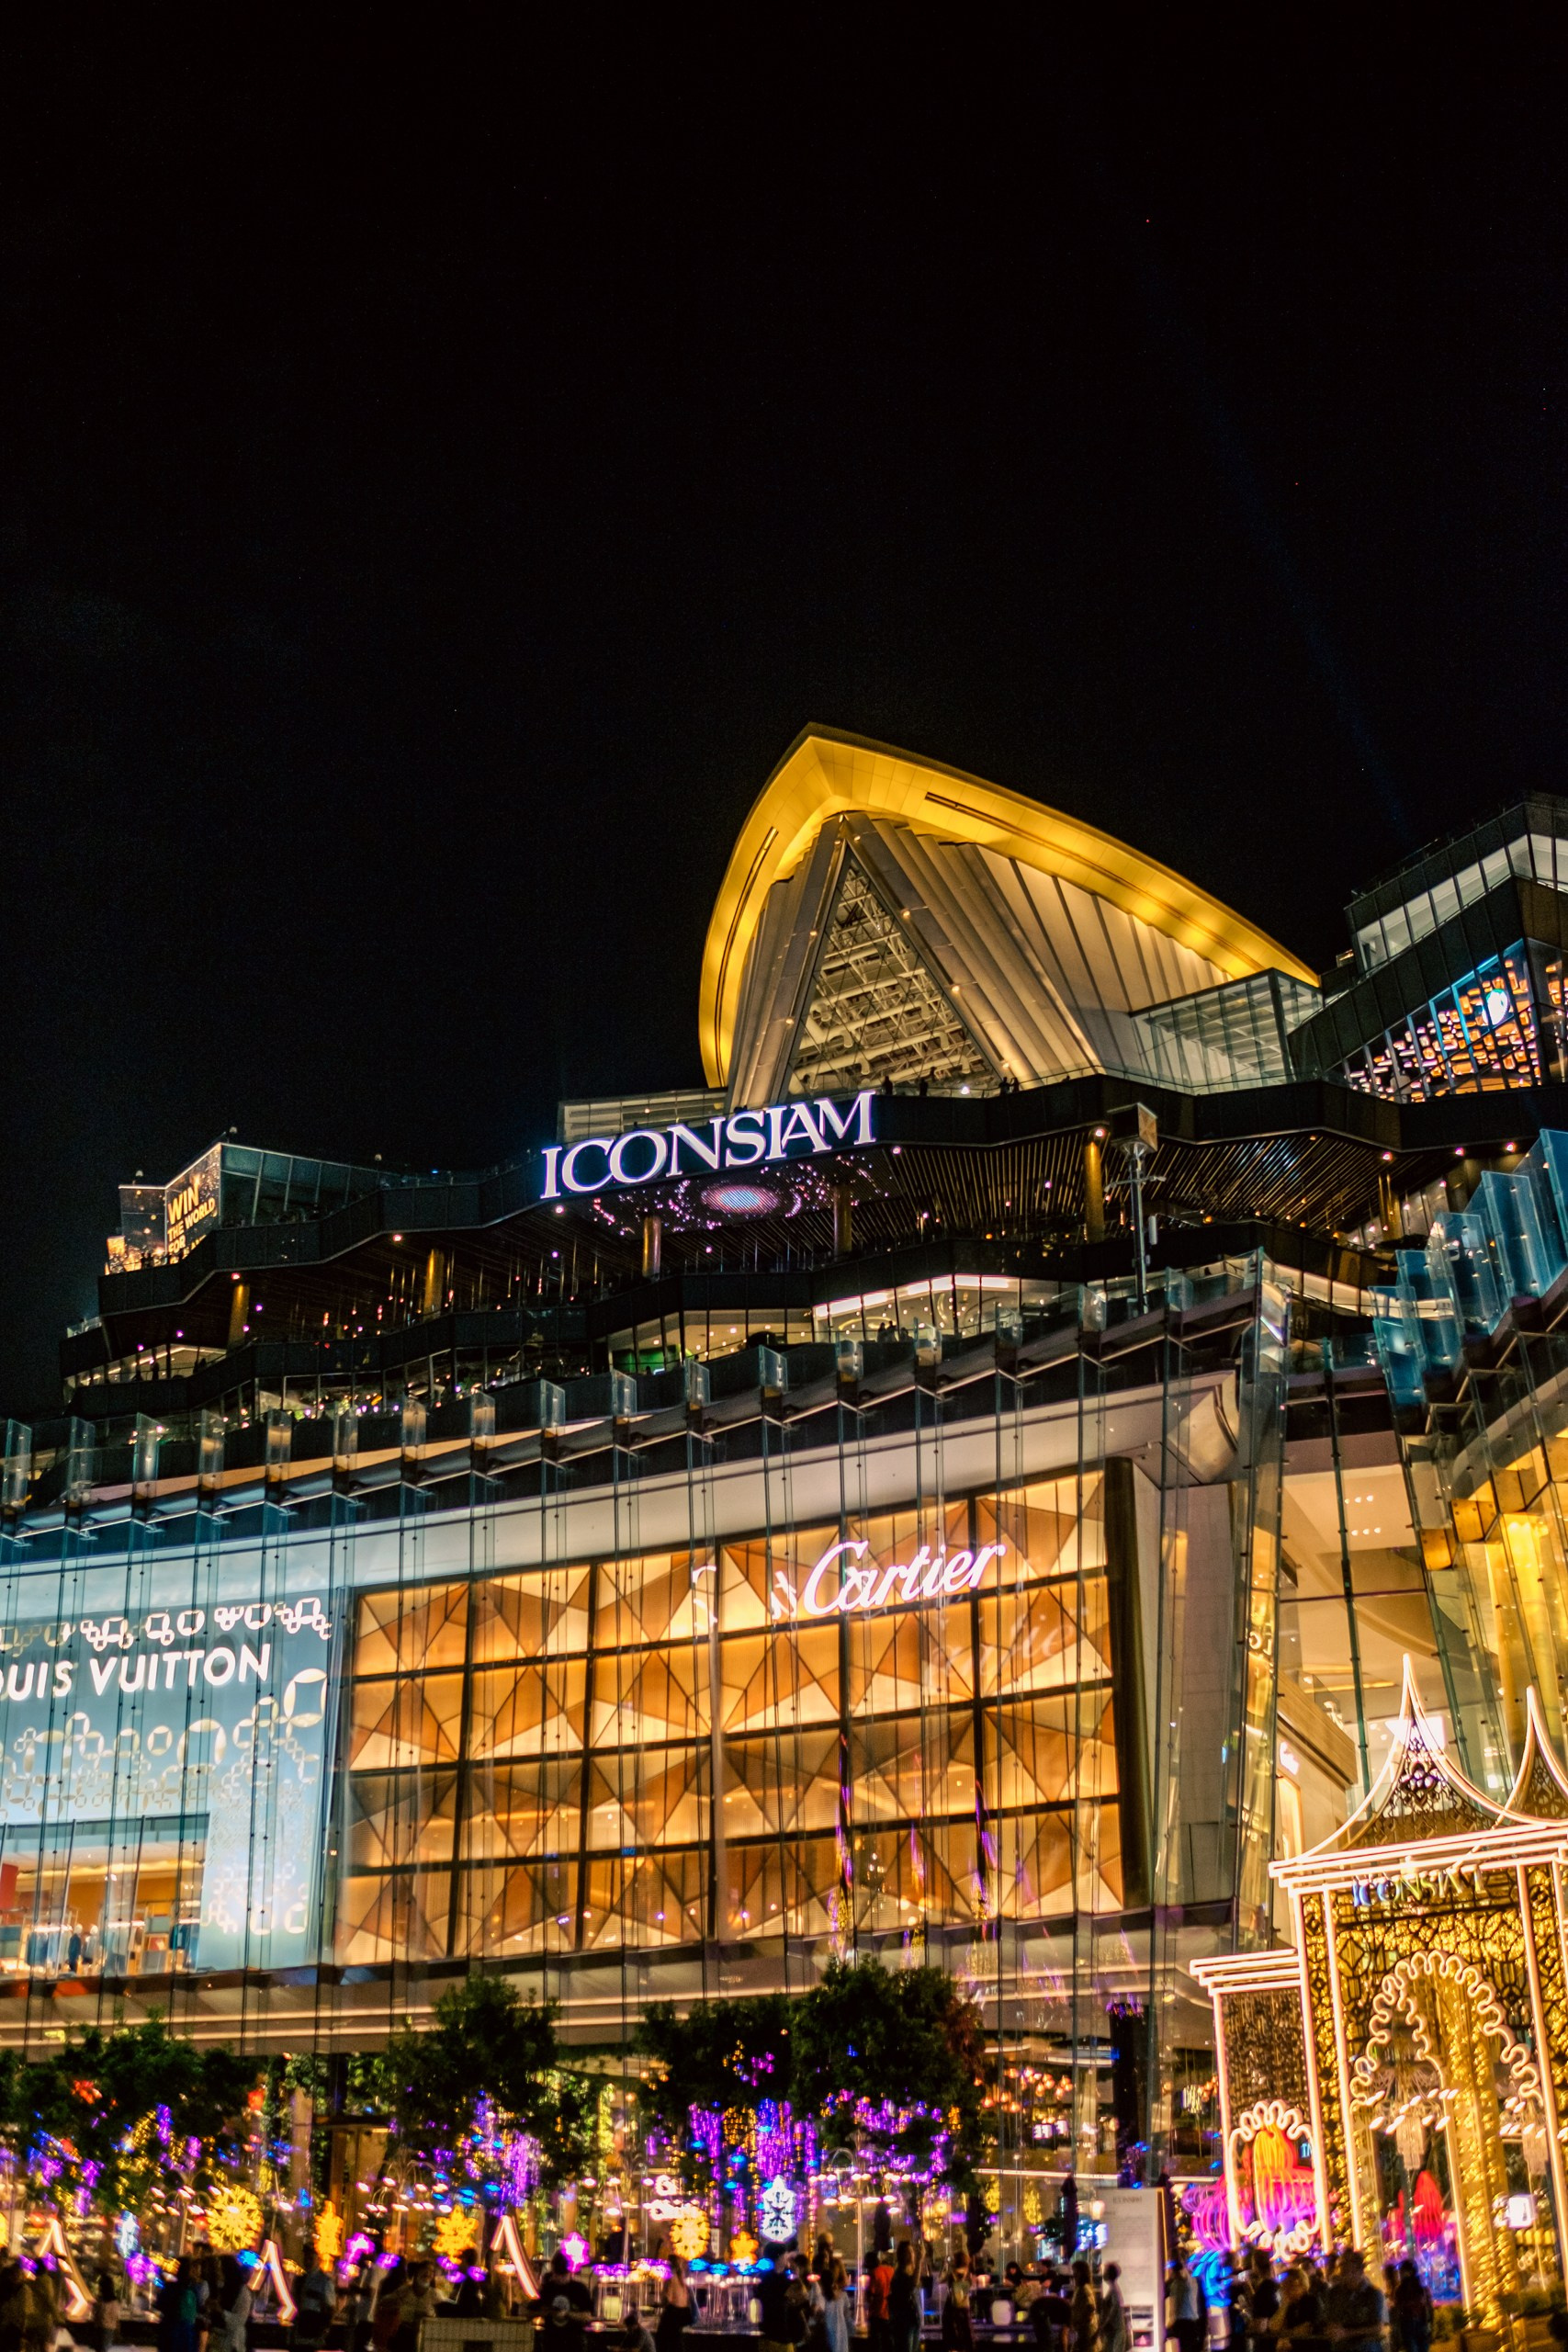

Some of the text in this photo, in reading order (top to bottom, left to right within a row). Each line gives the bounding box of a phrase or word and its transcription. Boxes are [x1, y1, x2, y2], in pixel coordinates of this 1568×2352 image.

[539, 1090, 876, 1200] ICONSIAM
[167, 1184, 199, 1225] WIN
[167, 1197, 216, 1242] THE WORLD
[168, 1234, 186, 1253] FOR
[803, 1540, 1007, 1616] Cartier
[0, 1643, 272, 1702] UIS VUITTON
